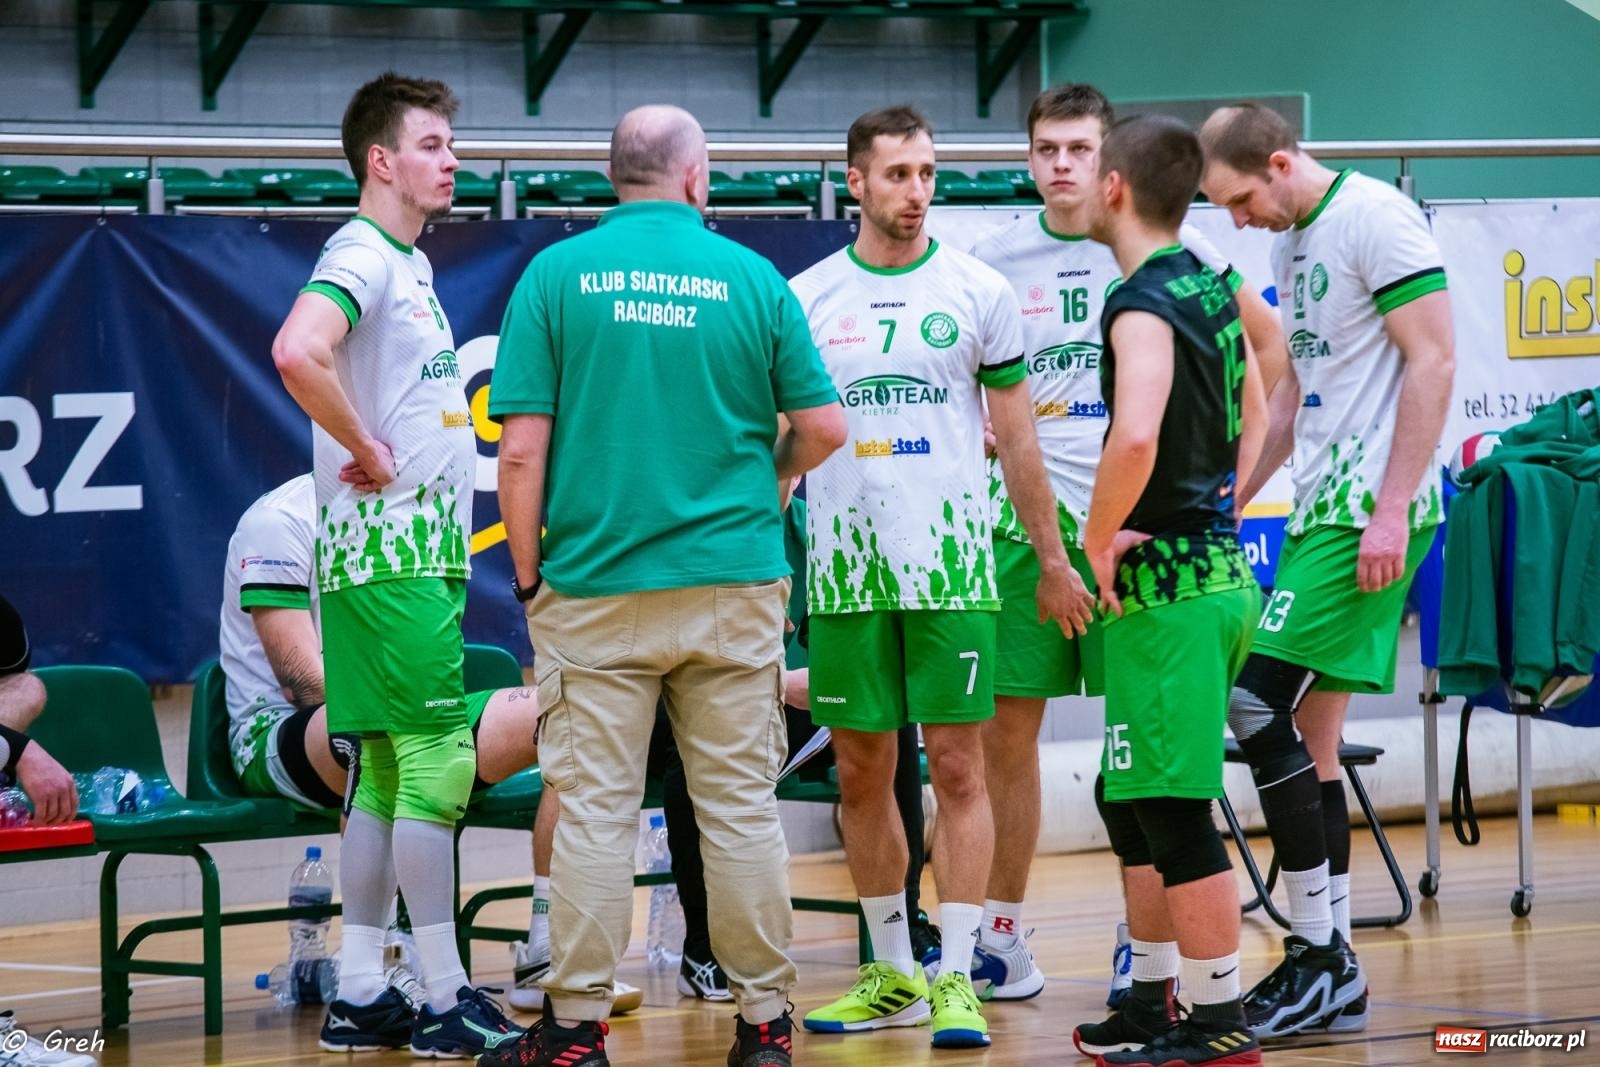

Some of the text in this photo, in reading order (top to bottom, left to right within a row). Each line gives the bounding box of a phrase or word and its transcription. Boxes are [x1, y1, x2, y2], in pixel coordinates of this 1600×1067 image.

[580, 271, 728, 302] KLUB SIATKARSKI
[428, 297, 444, 330] 6
[614, 300, 697, 328] RACIBÓRZ
[1059, 287, 1088, 323] 16
[829, 337, 867, 346] Racibórz
[878, 319, 897, 353] 7
[862, 407, 899, 416] KIETRZ
[1464, 393, 1494, 418] tel.
[1499, 394, 1518, 418] 32
[0, 391, 143, 517] RZ
[1257, 589, 1295, 632] 13
[959, 651, 979, 695] 7
[1105, 724, 1132, 771] 15
[991, 916, 1014, 934] R
